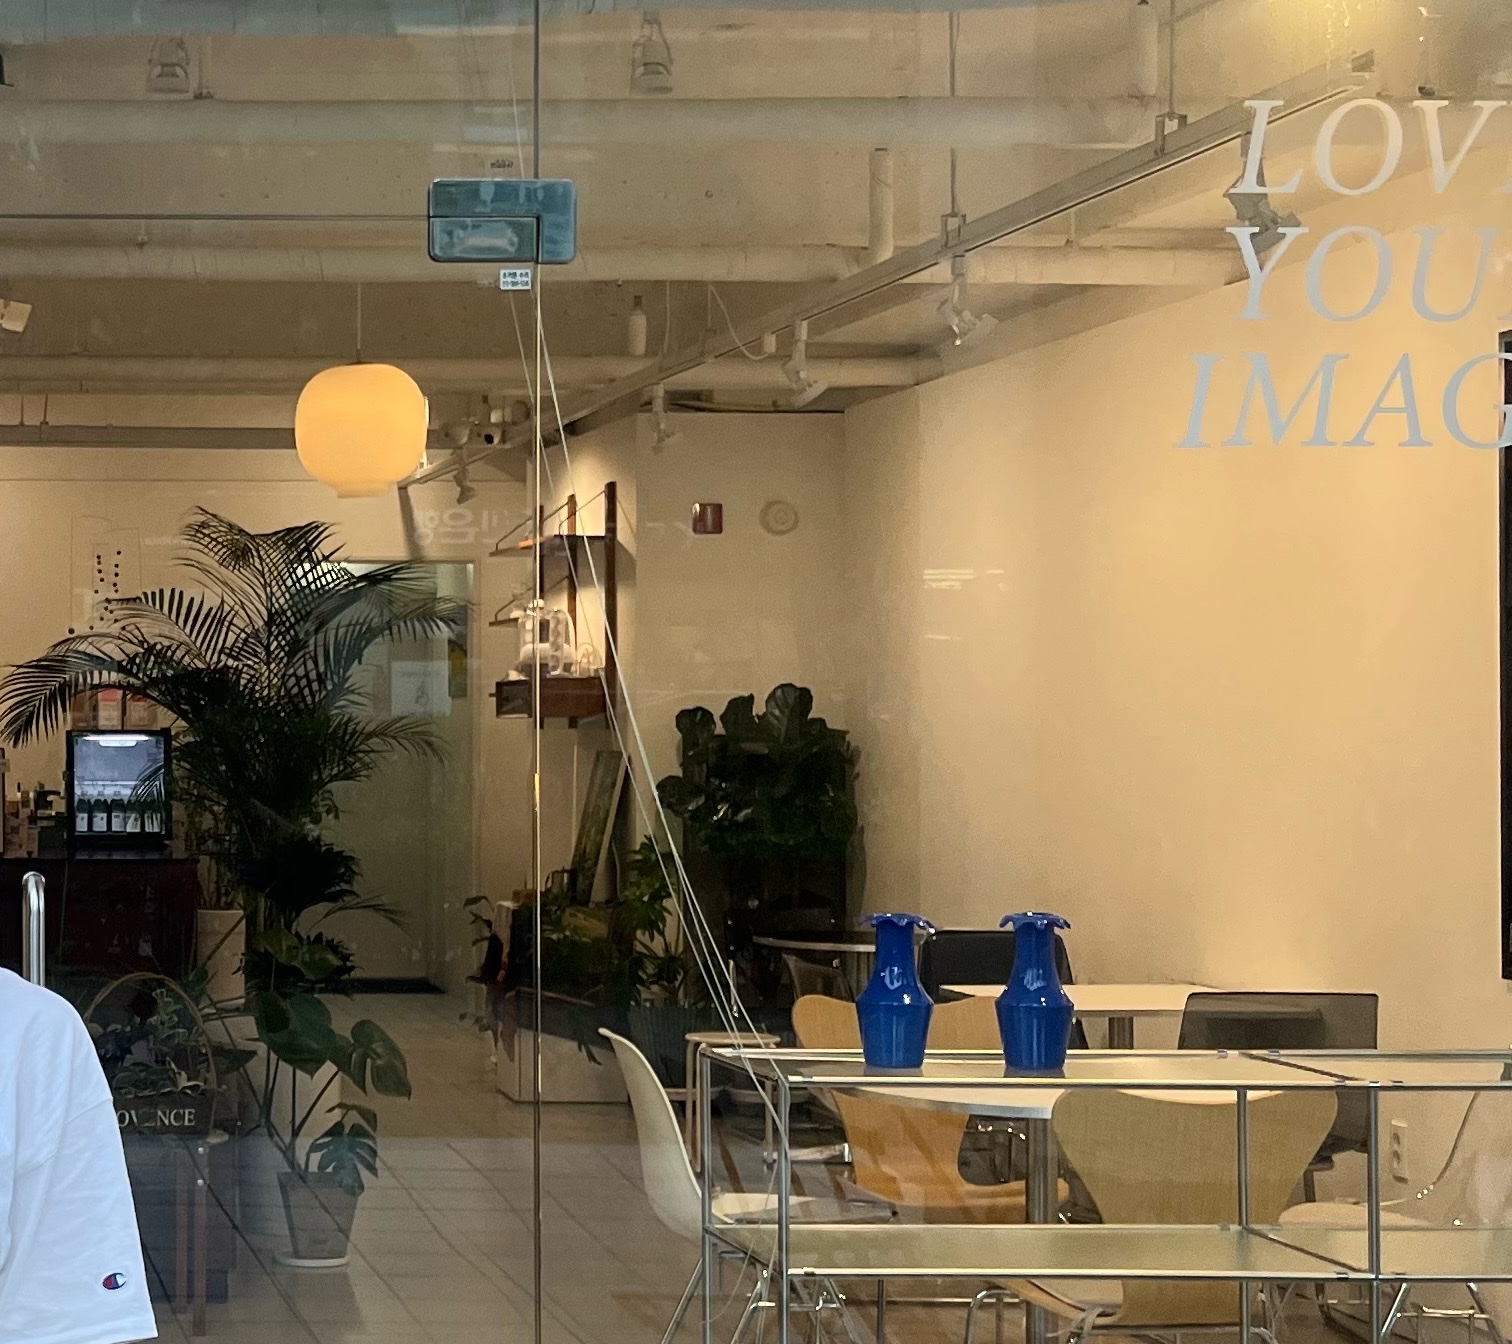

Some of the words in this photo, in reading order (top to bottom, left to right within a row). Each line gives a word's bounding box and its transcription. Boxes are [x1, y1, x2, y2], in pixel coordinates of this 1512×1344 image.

[1228, 98, 1512, 196] LOV
[1225, 226, 1512, 323] YOU
[116, 1108, 196, 1127] OVNCE
